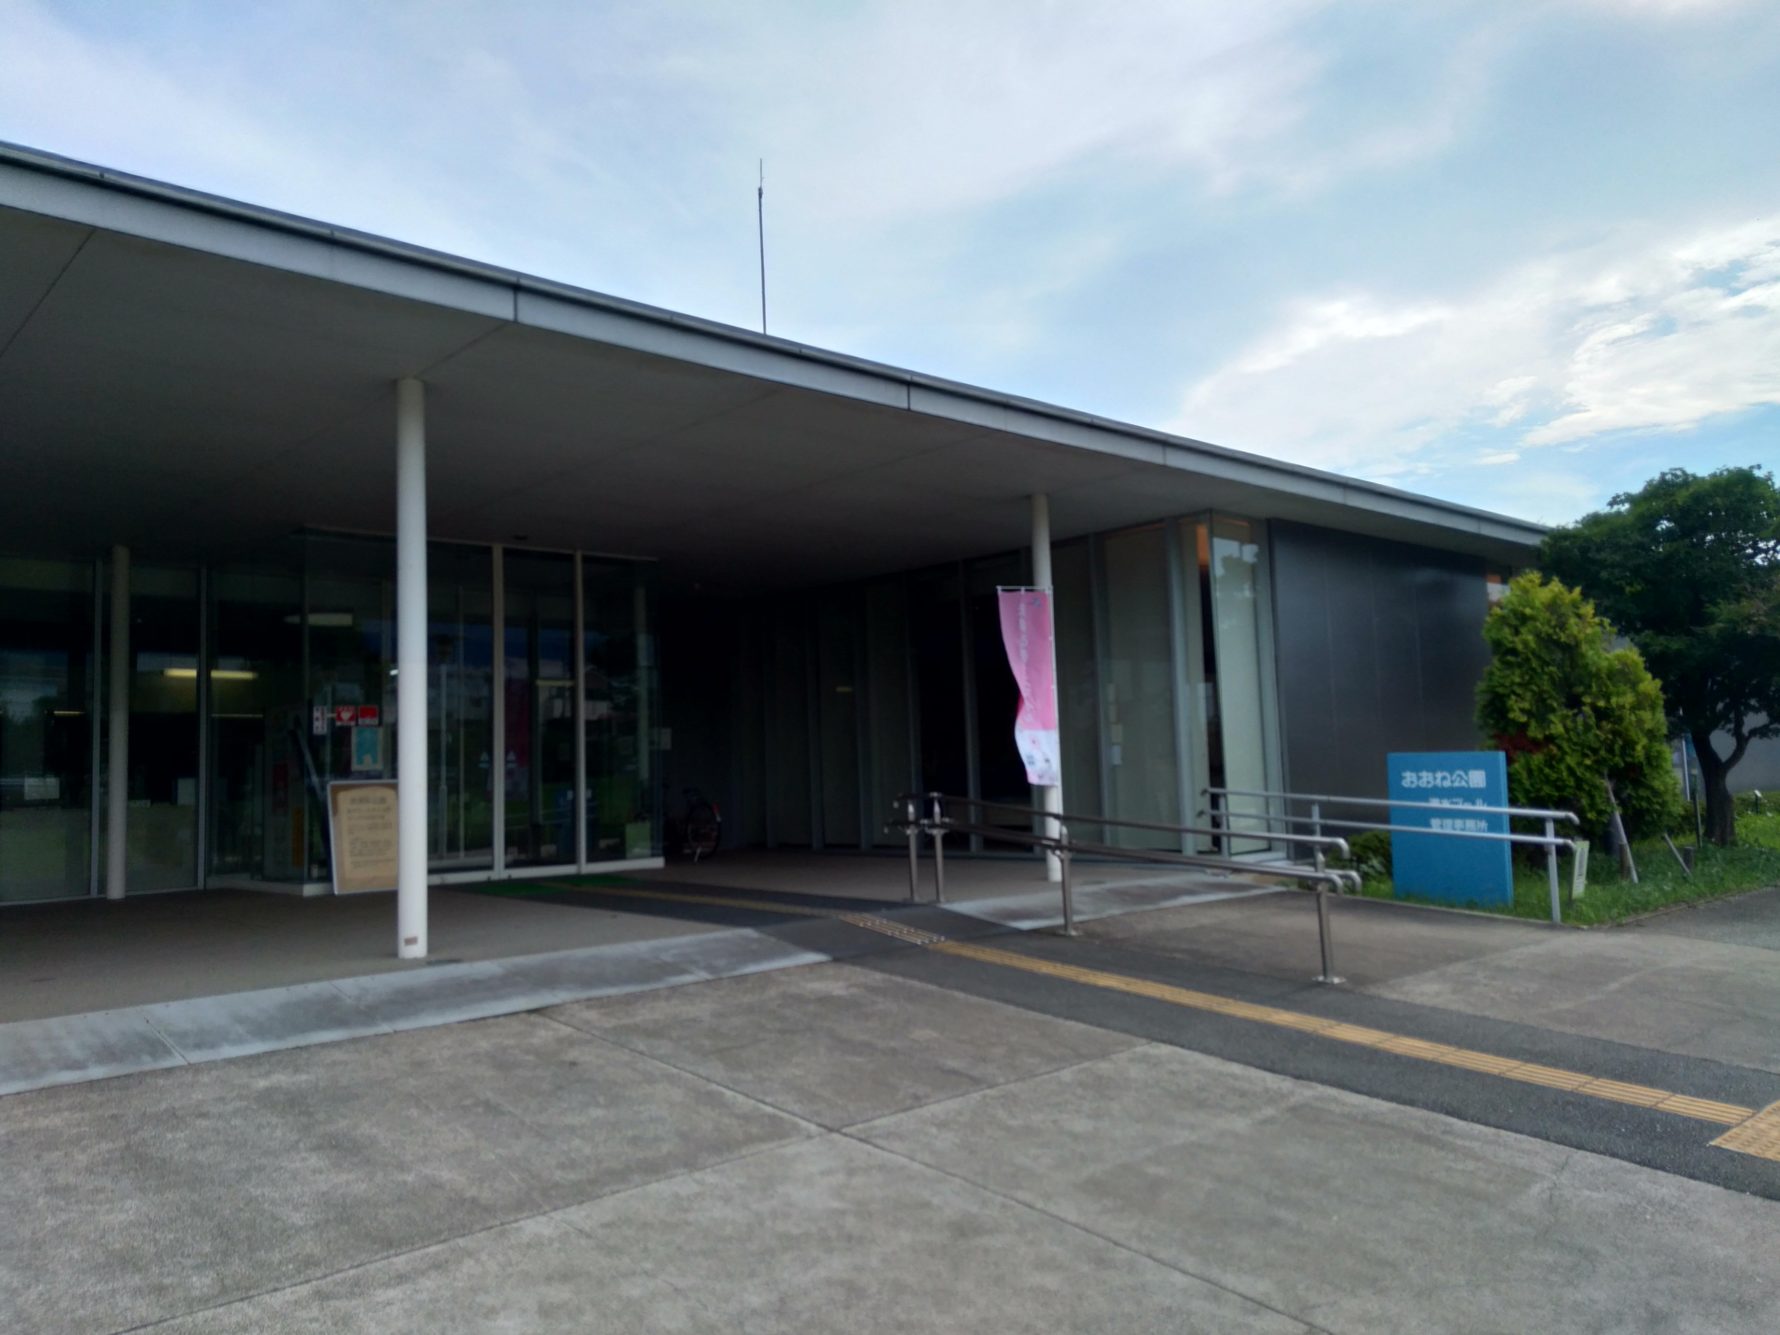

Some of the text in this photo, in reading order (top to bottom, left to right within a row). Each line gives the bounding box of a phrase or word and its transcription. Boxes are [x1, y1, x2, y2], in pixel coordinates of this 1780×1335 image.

[1401, 769, 1487, 788] おおね公園
